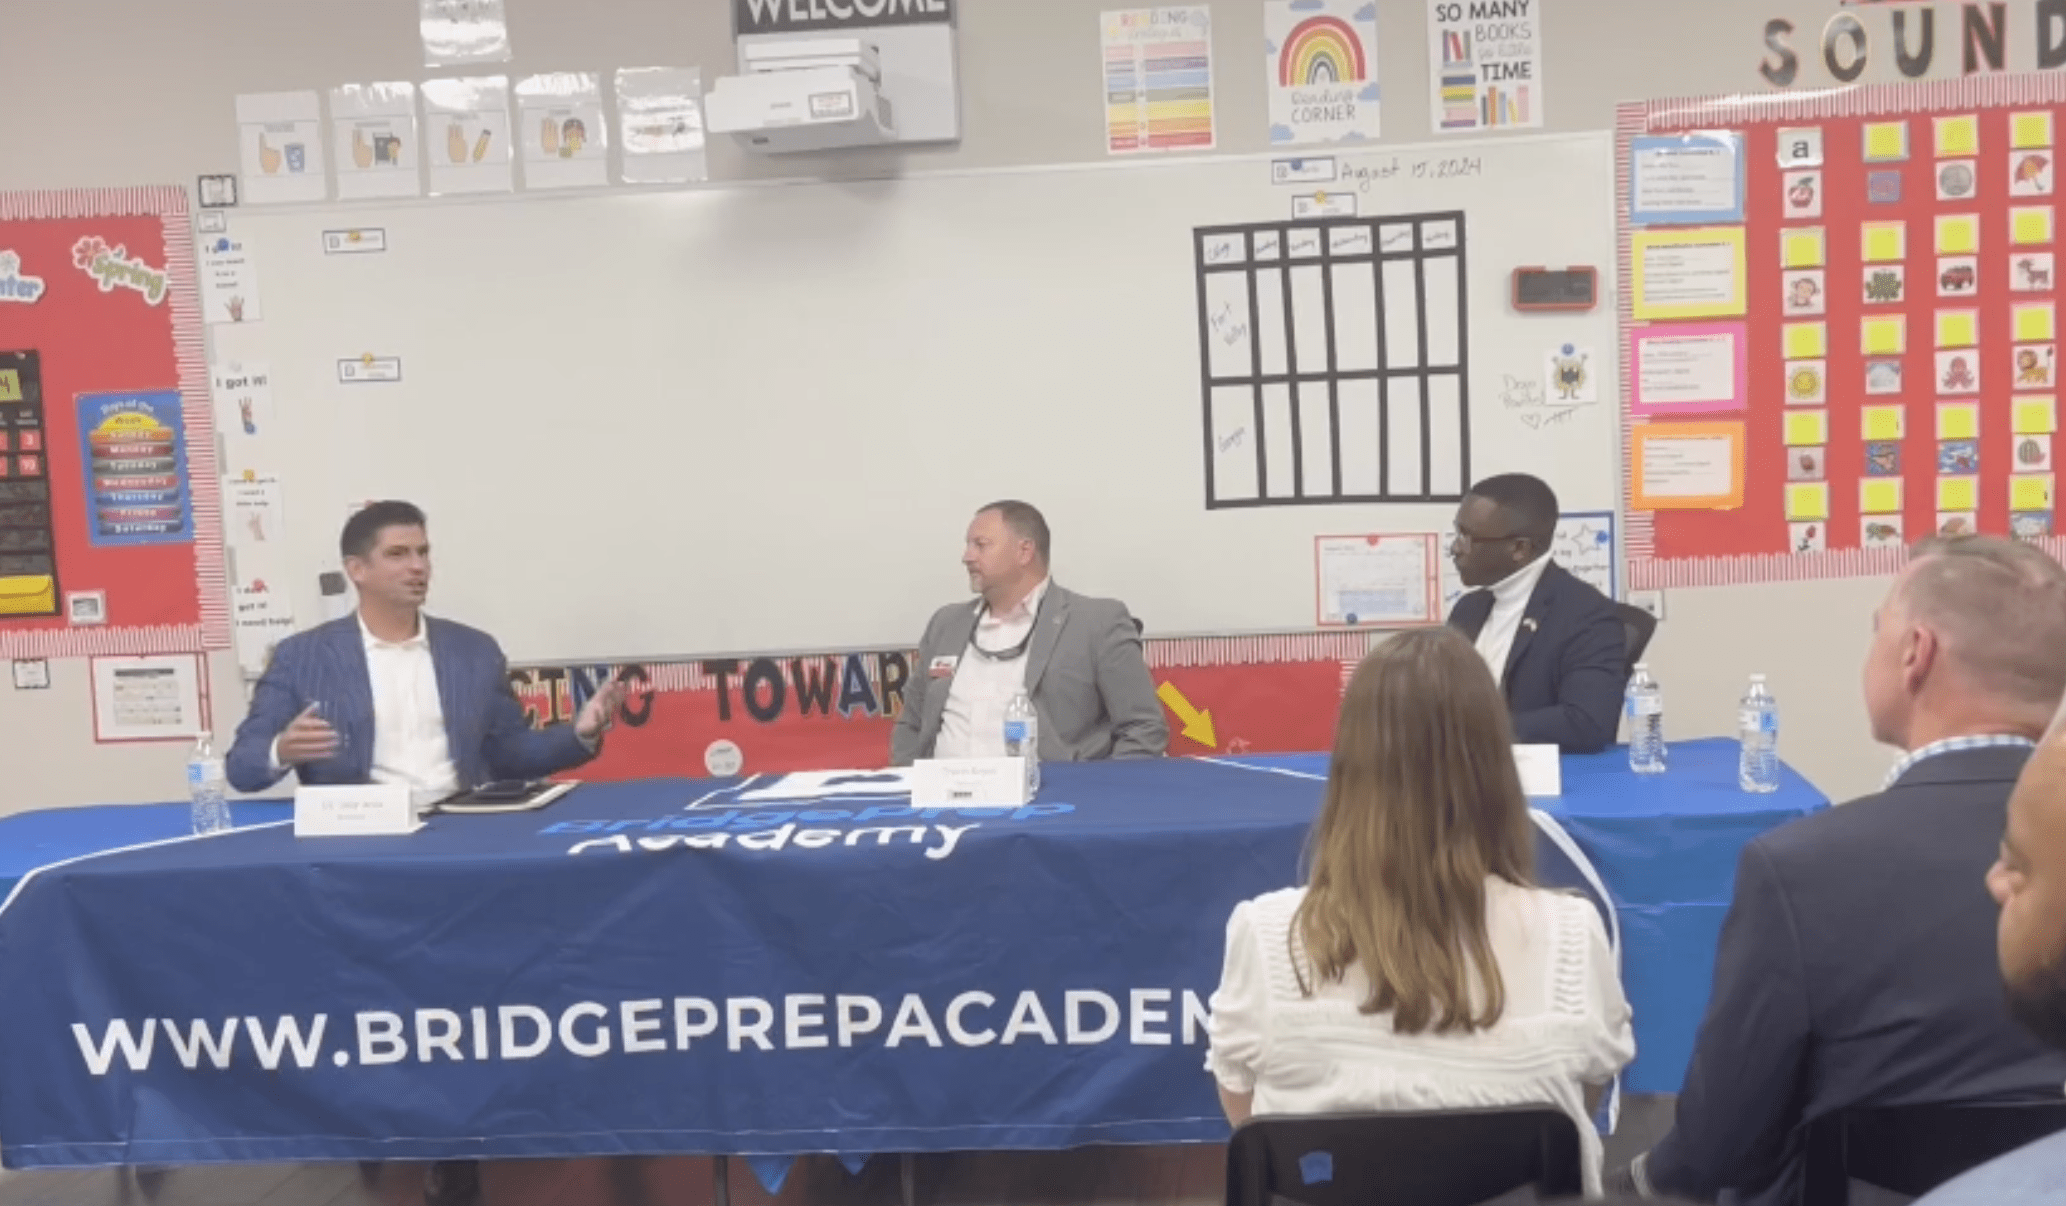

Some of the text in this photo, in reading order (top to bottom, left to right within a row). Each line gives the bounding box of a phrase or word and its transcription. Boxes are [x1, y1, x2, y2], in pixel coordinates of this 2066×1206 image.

[1436, 0, 1529, 22] SO MANY
[1475, 22, 1531, 42] BOOKS
[1759, 0, 2066, 87] SOUND
[1481, 61, 1532, 82] TIME
[1291, 104, 1355, 124] CORNER
[1792, 141, 1809, 158] a
[1342, 158, 1400, 192] August
[92, 251, 166, 300] Spring
[226, 376, 248, 390] got
